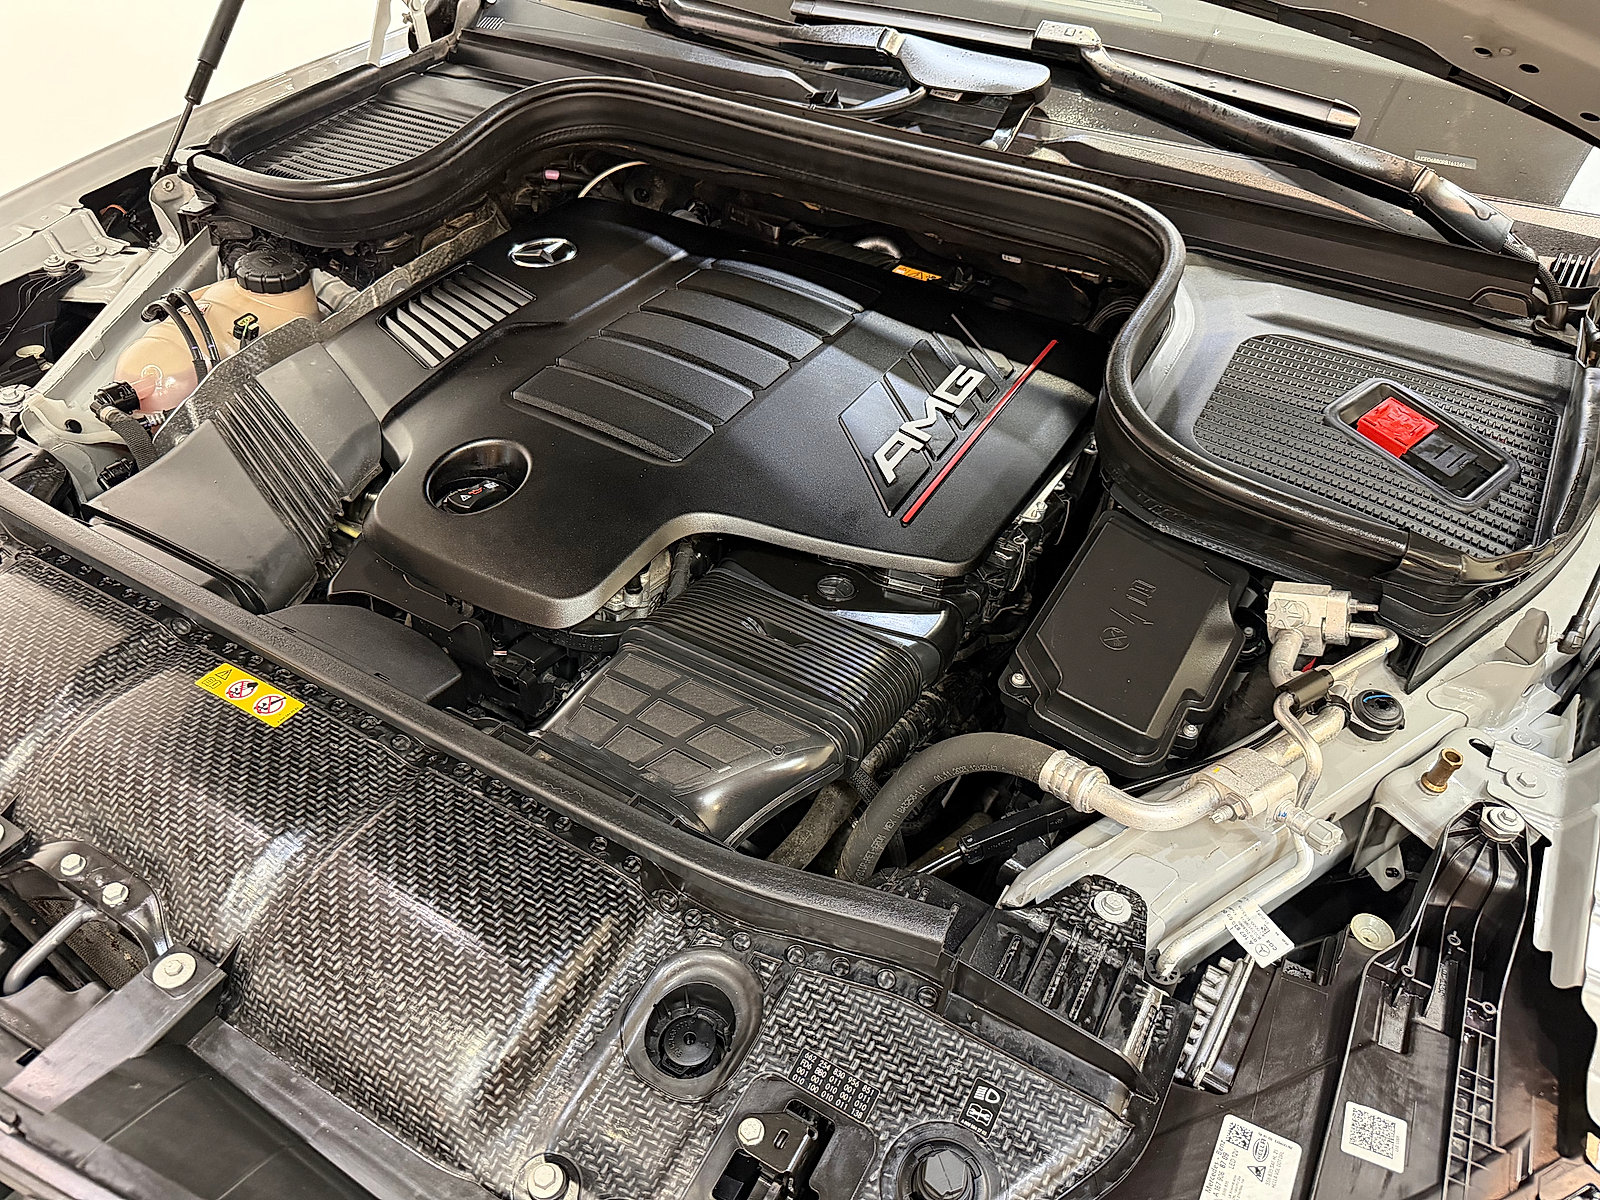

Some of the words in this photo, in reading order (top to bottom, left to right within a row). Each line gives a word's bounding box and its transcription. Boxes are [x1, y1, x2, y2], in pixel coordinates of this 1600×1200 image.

[873, 364, 987, 484] AMG
[796, 1067, 808, 1077] 001
[811, 1075, 823, 1085] 001
[825, 1083, 837, 1094] 010
[840, 1092, 852, 1102] 001
[854, 1100, 866, 1111] 010
[805, 1052, 817, 1063] 662
[833, 1068, 845, 1078] 830
[848, 1077, 859, 1087] 956
[862, 1085, 874, 1095] 851
[829, 1076, 841, 1086] 011
[844, 1084, 856, 1095] 001
[858, 1093, 870, 1103] 011
[792, 1074, 804, 1085] 010
[808, 1083, 819, 1093] 100
[821, 1091, 833, 1101] 010
[836, 1100, 848, 1110] 011
[851, 1108, 863, 1118] 138
[1205, 1161, 1219, 1193] Mercedes
[1216, 1140, 1226, 1155] Benz
